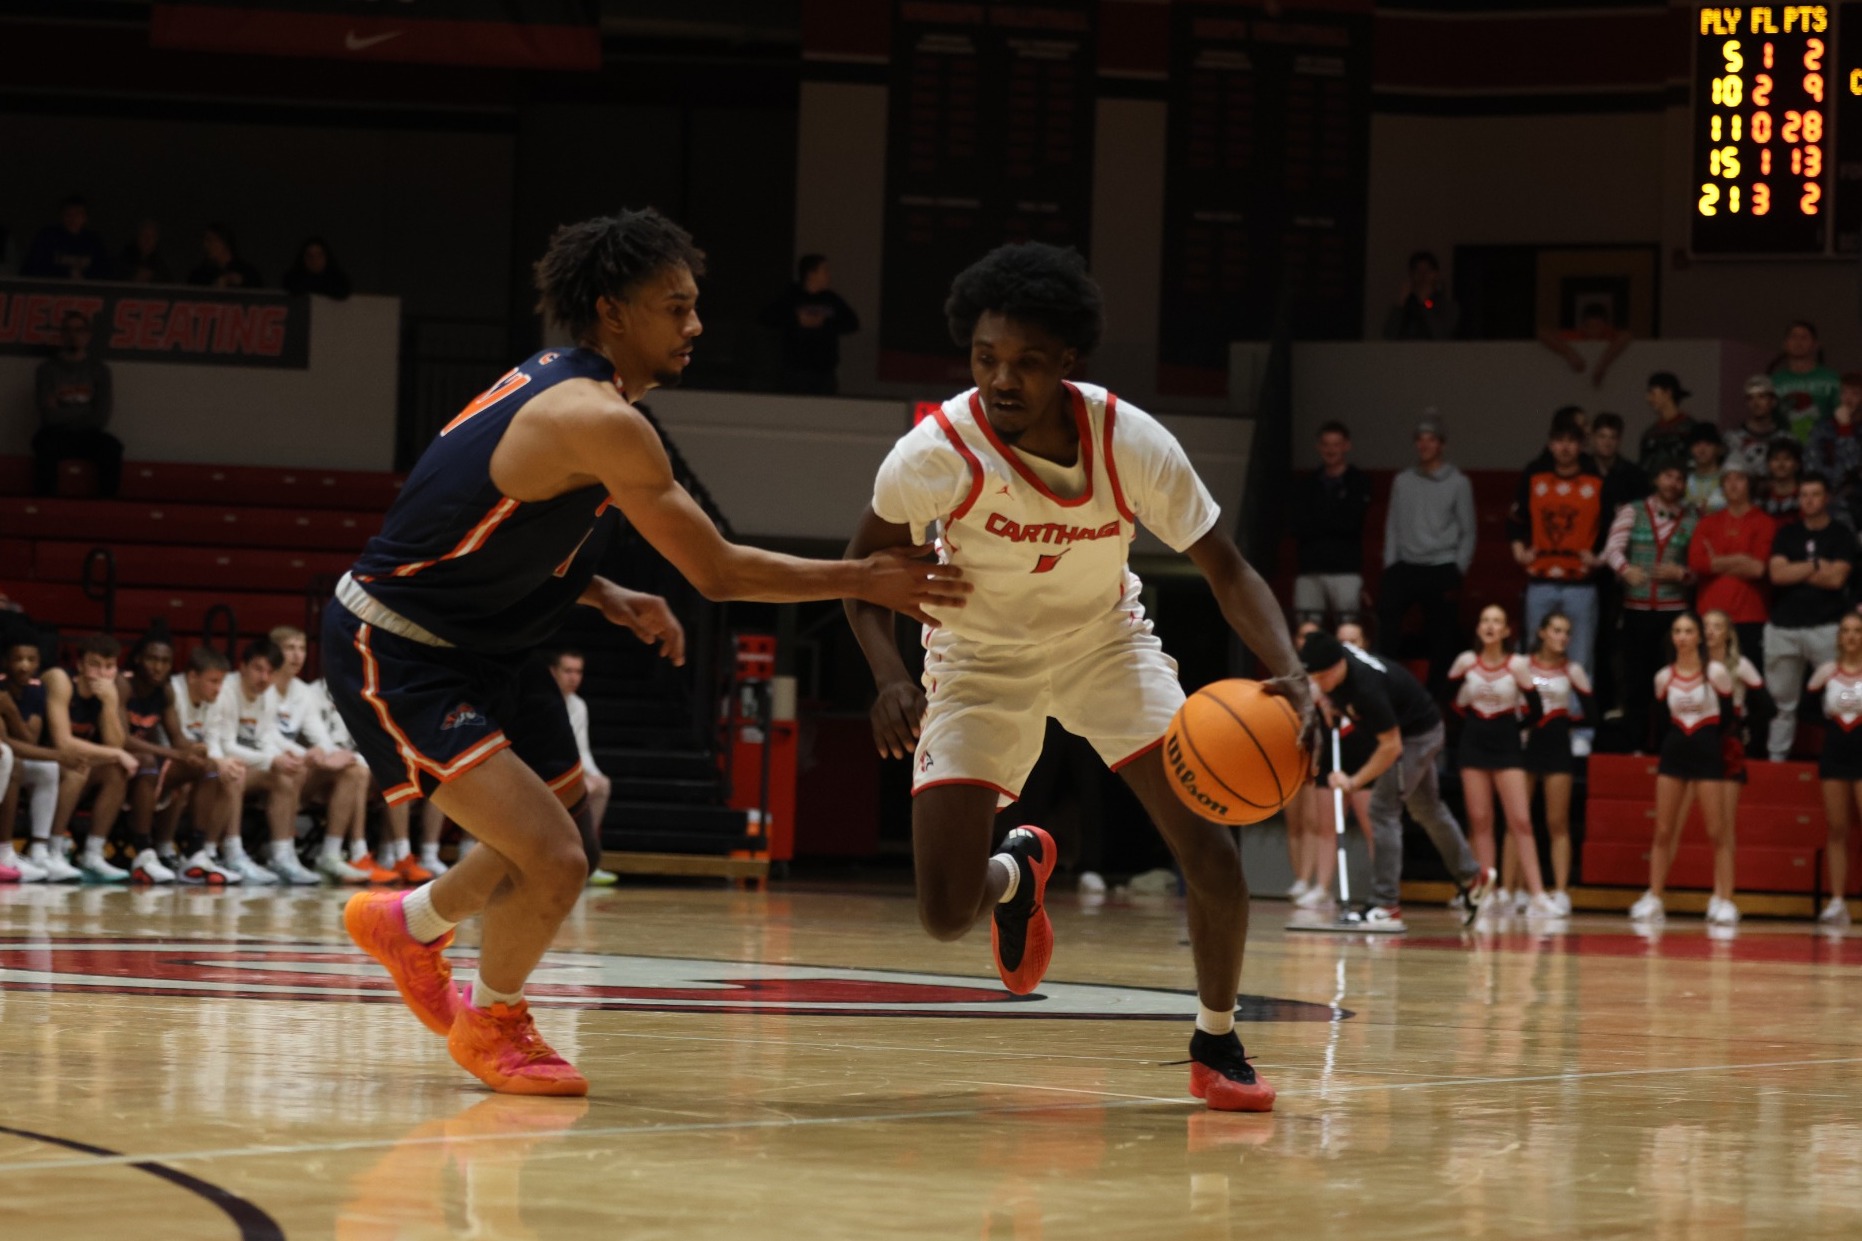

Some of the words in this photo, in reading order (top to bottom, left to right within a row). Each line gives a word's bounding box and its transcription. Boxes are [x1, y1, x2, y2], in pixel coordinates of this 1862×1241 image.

[1751, 7, 1779, 34] FL
[1784, 5, 1828, 33] PTS
[1722, 40, 1744, 73] 5
[1763, 42, 1774, 69] 1
[1803, 38, 1825, 71] 2
[1712, 74, 1743, 107] 10
[1752, 73, 1773, 107] 2
[1803, 72, 1824, 103] 9
[1711, 114, 1742, 142] 11
[1751, 110, 1772, 144] 0
[1781, 109, 1823, 143] 28
[1710, 145, 1741, 179] 15
[1760, 148, 1771, 175] 1
[1791, 144, 1822, 178] 13
[1698, 183, 1740, 217] 21
[1752, 182, 1771, 216] 3
[1800, 181, 1821, 215] 2
[109, 298, 289, 357] SEATING
[1168, 731, 1229, 815] Wilson
